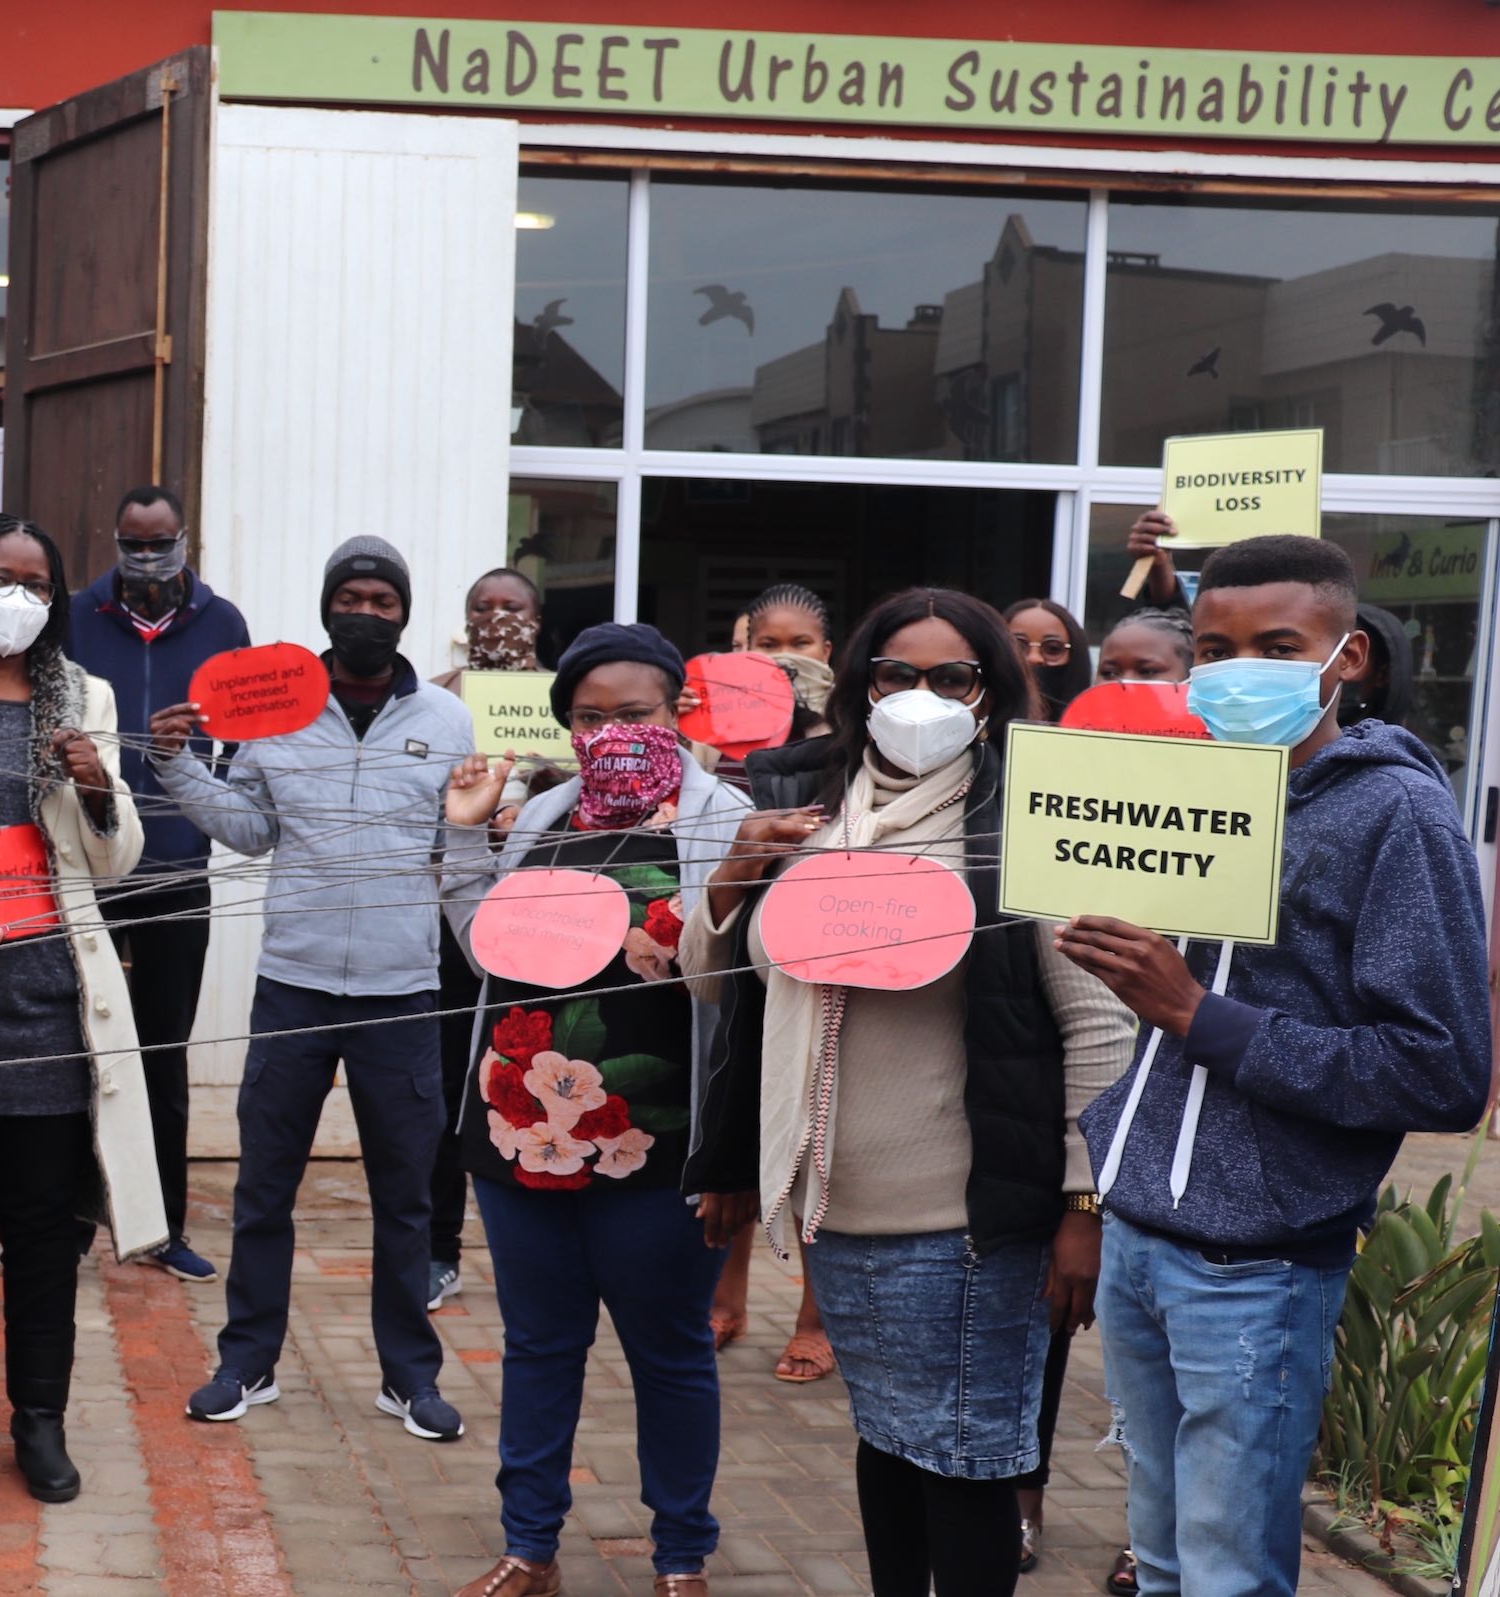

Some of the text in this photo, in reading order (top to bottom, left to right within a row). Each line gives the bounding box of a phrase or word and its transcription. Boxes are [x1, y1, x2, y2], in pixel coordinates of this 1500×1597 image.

[412, 28, 680, 102] NaDEET
[718, 38, 905, 108] Urban
[944, 49, 1408, 143] Sustainability
[1175, 468, 1307, 489] BIODIVERSITY
[1215, 496, 1261, 512] LOSS
[1407, 549, 1423, 577] &
[1429, 546, 1477, 577] Curio
[209, 664, 304, 692] Unplanned and
[230, 683, 288, 703] increased
[224, 697, 300, 720] urbanisation
[488, 704, 534, 718] LAND
[494, 726, 561, 740] CHANGE
[1028, 791, 1253, 837] FRESHWATER
[1055, 839, 1216, 878] SCARCITY
[819, 894, 917, 919] Open-fire
[822, 920, 903, 944] cooking
